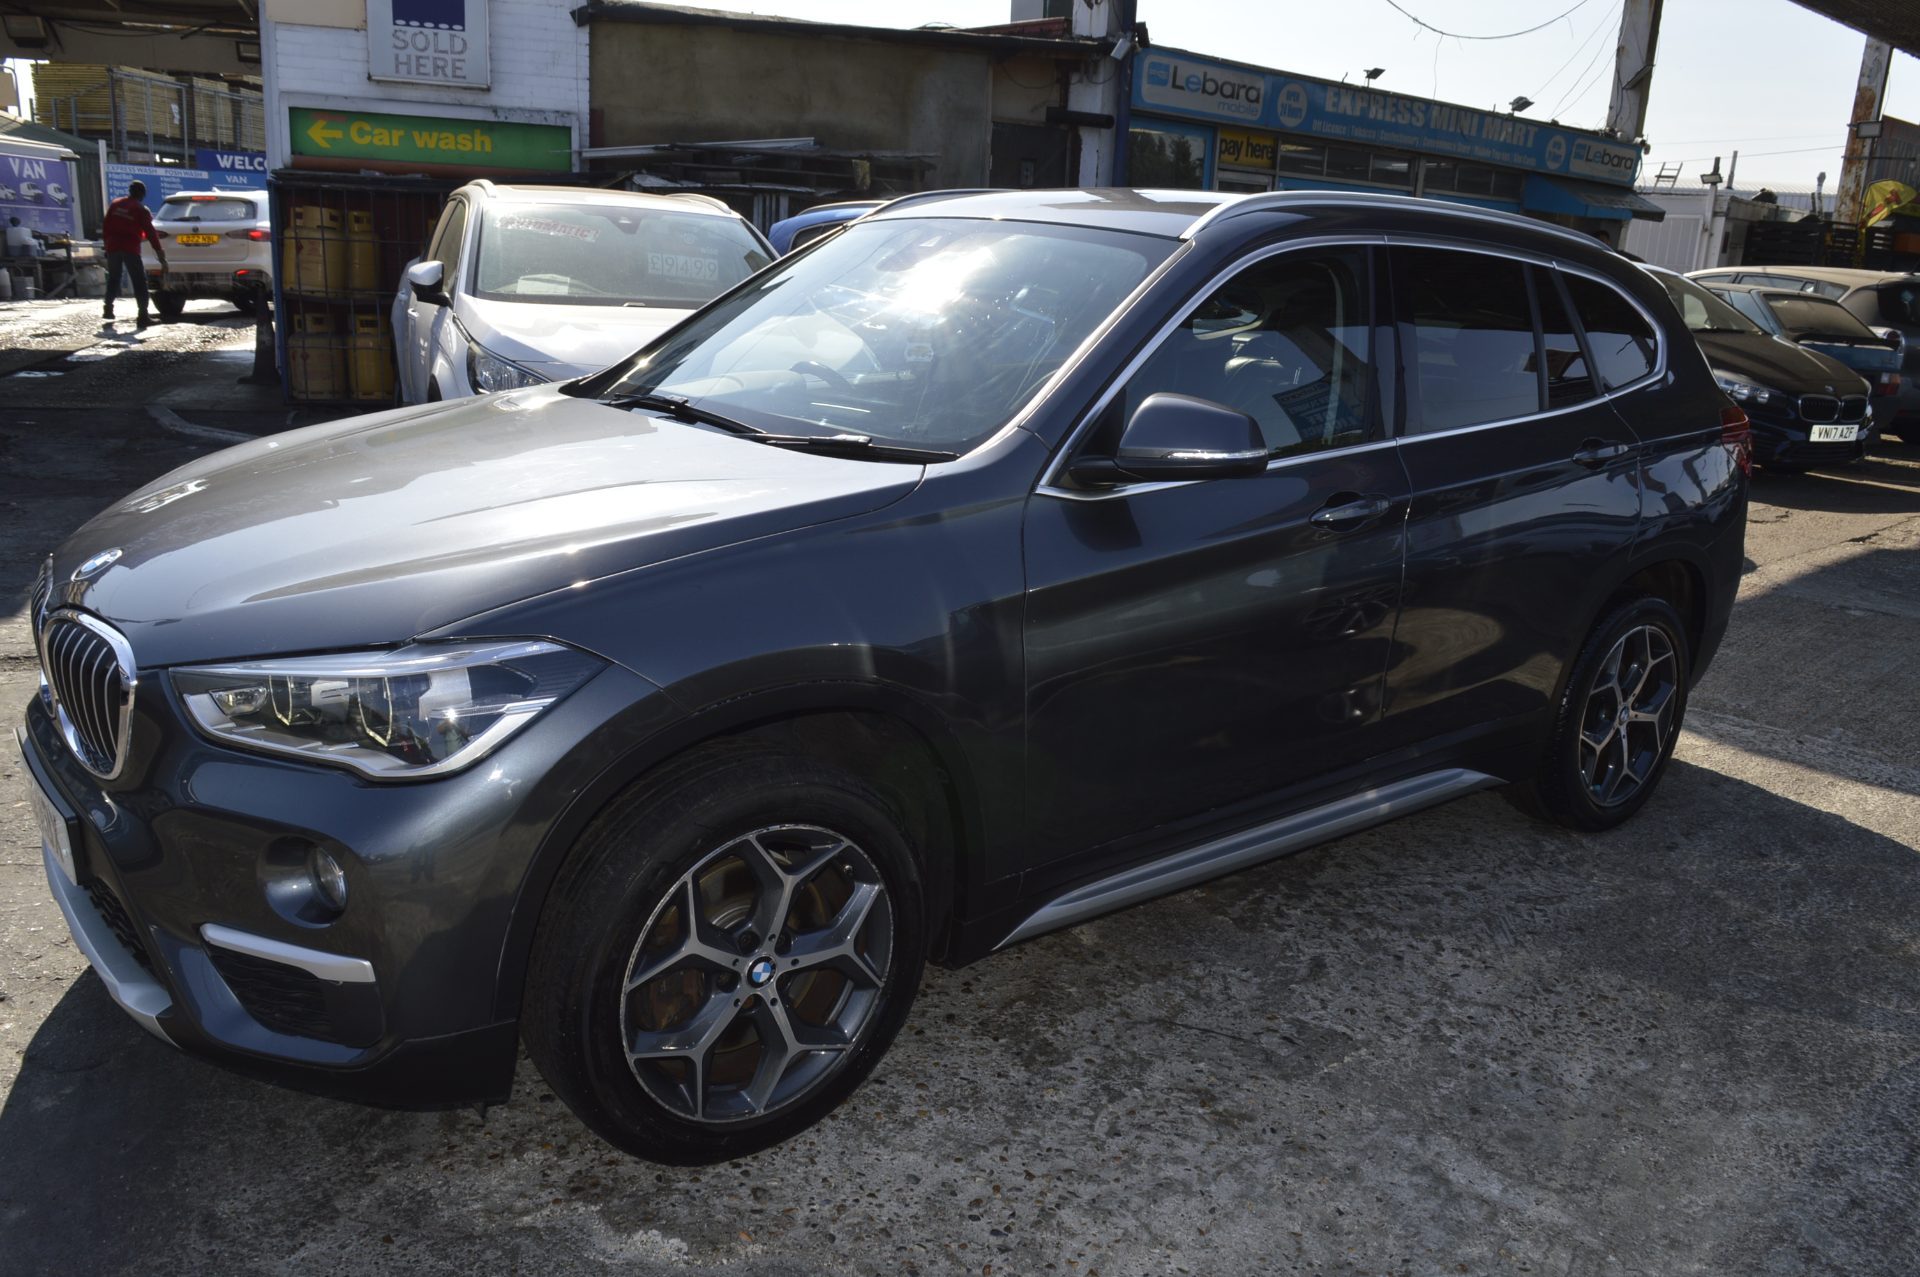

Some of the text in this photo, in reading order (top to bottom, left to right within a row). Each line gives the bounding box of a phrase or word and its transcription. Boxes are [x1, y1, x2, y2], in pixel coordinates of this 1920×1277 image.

[392, 29, 467, 55] SOLD
[394, 54, 467, 79] HERE
[1171, 65, 1261, 104] Lebara
[1218, 99, 1259, 115] mobile
[1325, 85, 1539, 148] EXPRESS MINI MART
[350, 121, 492, 153] Car wash
[1220, 136, 1273, 162] pay here
[8, 157, 47, 180] VAN
[1584, 145, 1634, 171] Lebara
[225, 174, 248, 184] VAN
[1818, 426, 1855, 439] VN17 AZF
